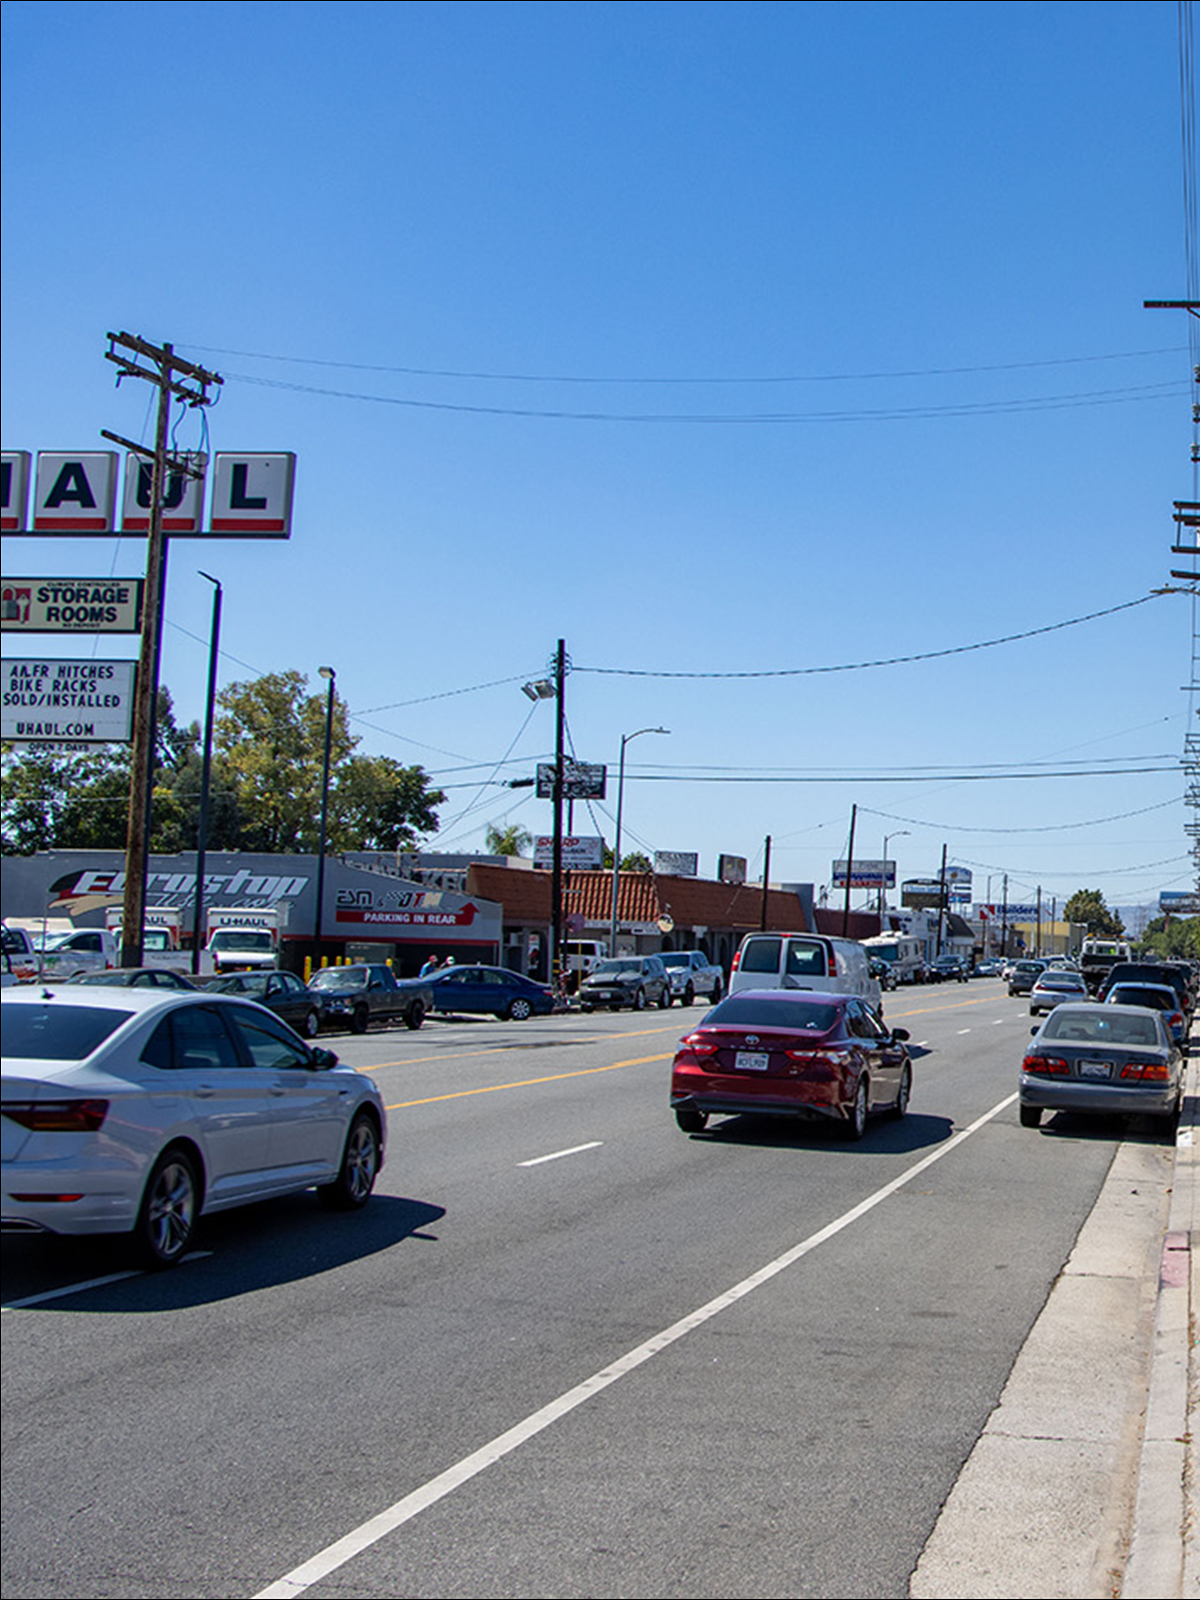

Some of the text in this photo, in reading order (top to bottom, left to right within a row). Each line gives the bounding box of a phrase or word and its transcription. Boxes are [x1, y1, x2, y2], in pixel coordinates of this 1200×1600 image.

[1, 462, 267, 509] AUL
[36, 587, 130, 604] STORAGE
[46, 606, 118, 623] ROOMS
[58, 665, 114, 679] HITCHES
[10, 679, 97, 693] BIKE RACKS
[3, 692, 121, 708] SOLD/INSTALLED
[16, 722, 95, 736] UHAUL.COM
[220, 917, 268, 926] U-HAUL
[363, 912, 457, 925] PARKING IN REAR
